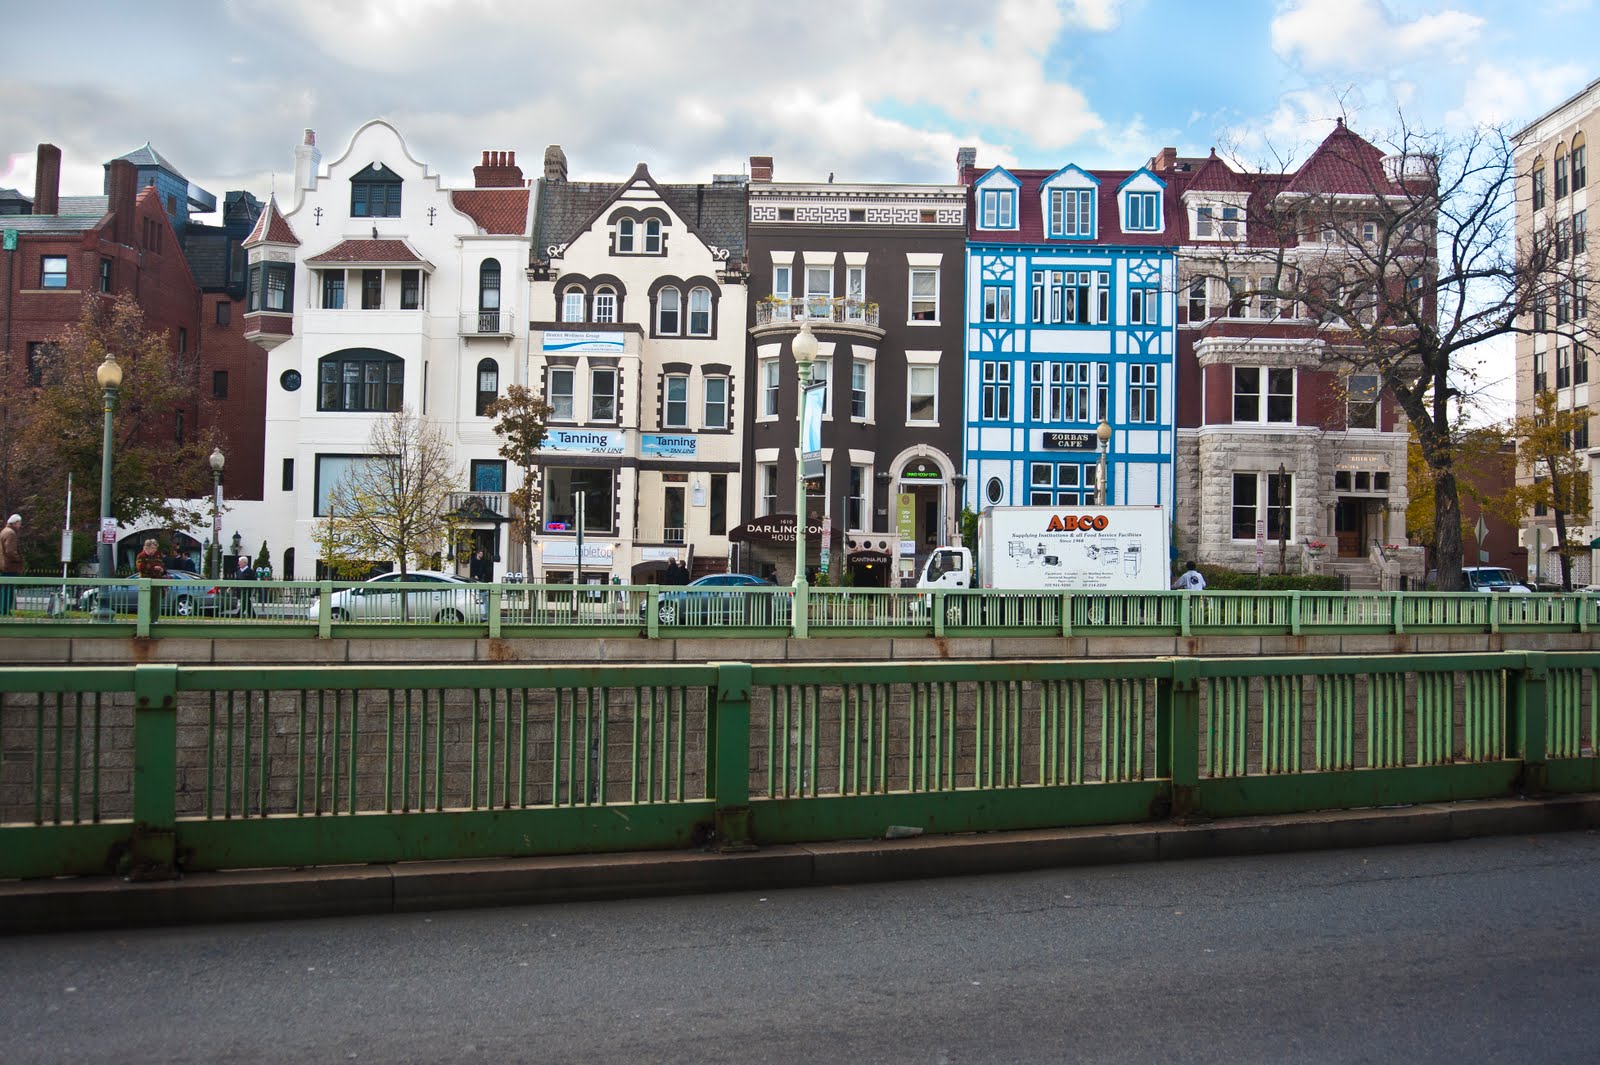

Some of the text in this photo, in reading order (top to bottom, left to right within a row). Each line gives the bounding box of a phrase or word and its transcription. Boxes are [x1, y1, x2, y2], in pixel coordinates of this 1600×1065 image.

[557, 431, 608, 447] Tanning
[656, 436, 696, 448] Tanning
[1051, 433, 1089, 441] ZORBA'S
[1057, 440, 1083, 448] CAFE
[1046, 514, 1109, 532] ABCO
[747, 524, 823, 534] DARLINON
